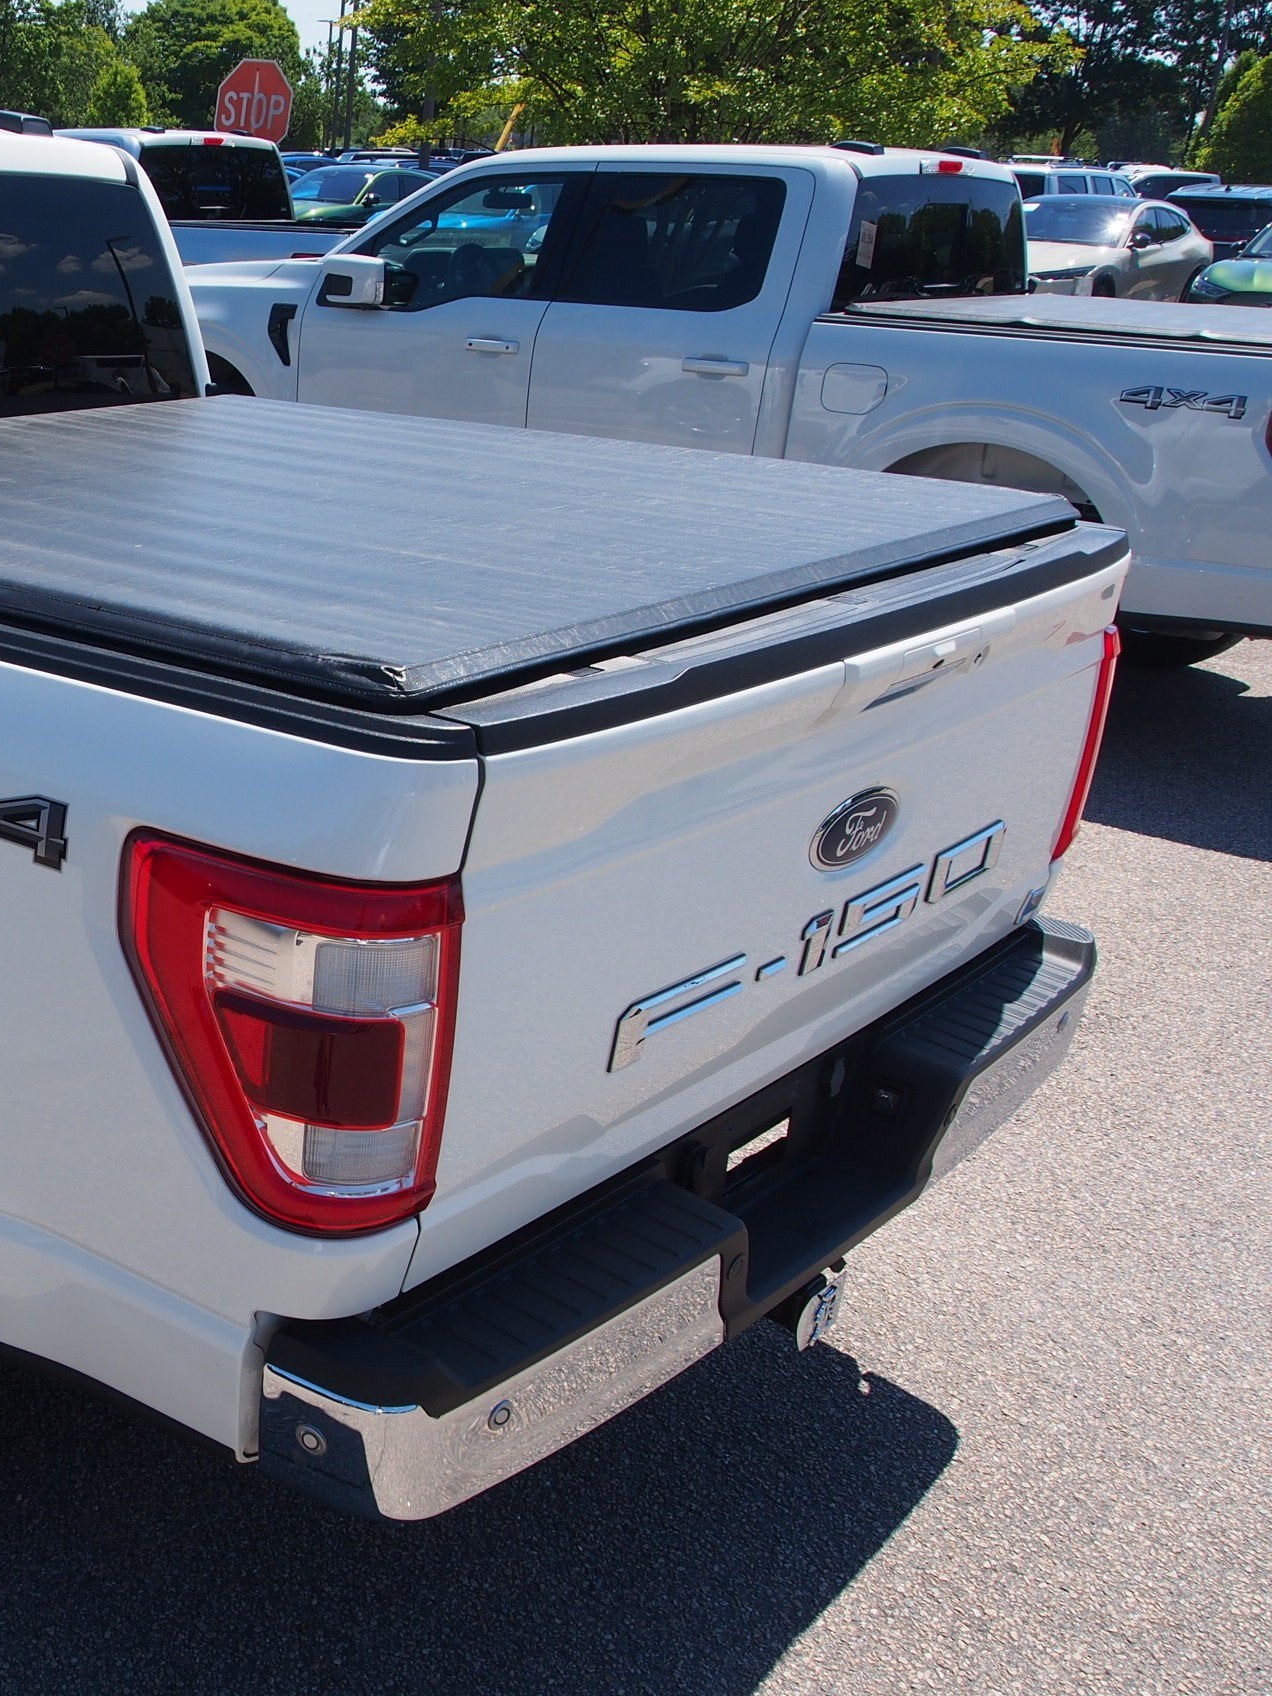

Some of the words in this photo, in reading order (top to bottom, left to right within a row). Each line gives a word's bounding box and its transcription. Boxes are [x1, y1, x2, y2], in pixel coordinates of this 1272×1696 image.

[221, 91, 286, 129] STOP
[836, 806, 888, 857] Ford
[606, 819, 1007, 1073] F-150
